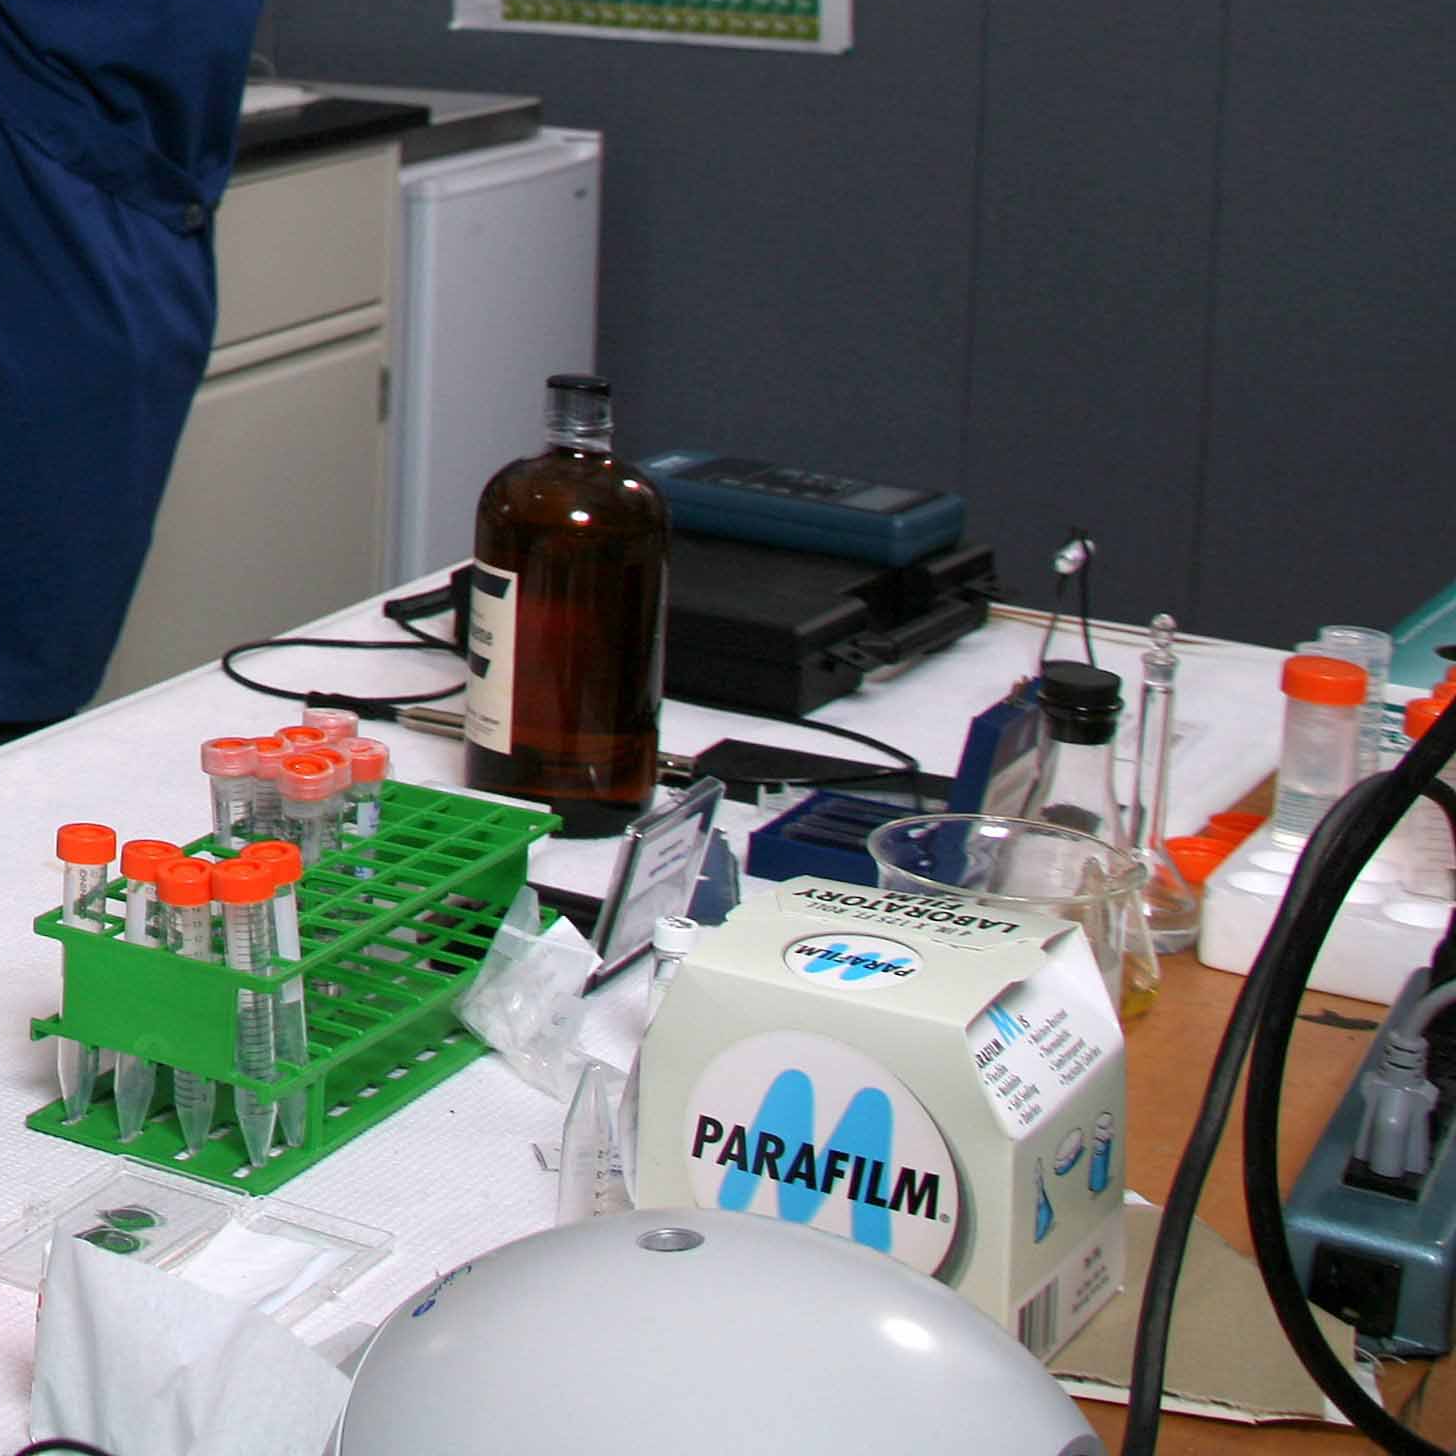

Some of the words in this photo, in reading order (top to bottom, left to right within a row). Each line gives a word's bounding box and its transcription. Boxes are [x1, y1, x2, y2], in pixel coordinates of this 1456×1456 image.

[793, 888, 1020, 934] LABORATORY
[882, 891, 965, 911] FILM
[794, 944, 917, 977] PARAFILM
[691, 1114, 941, 1221] PARAFILM
